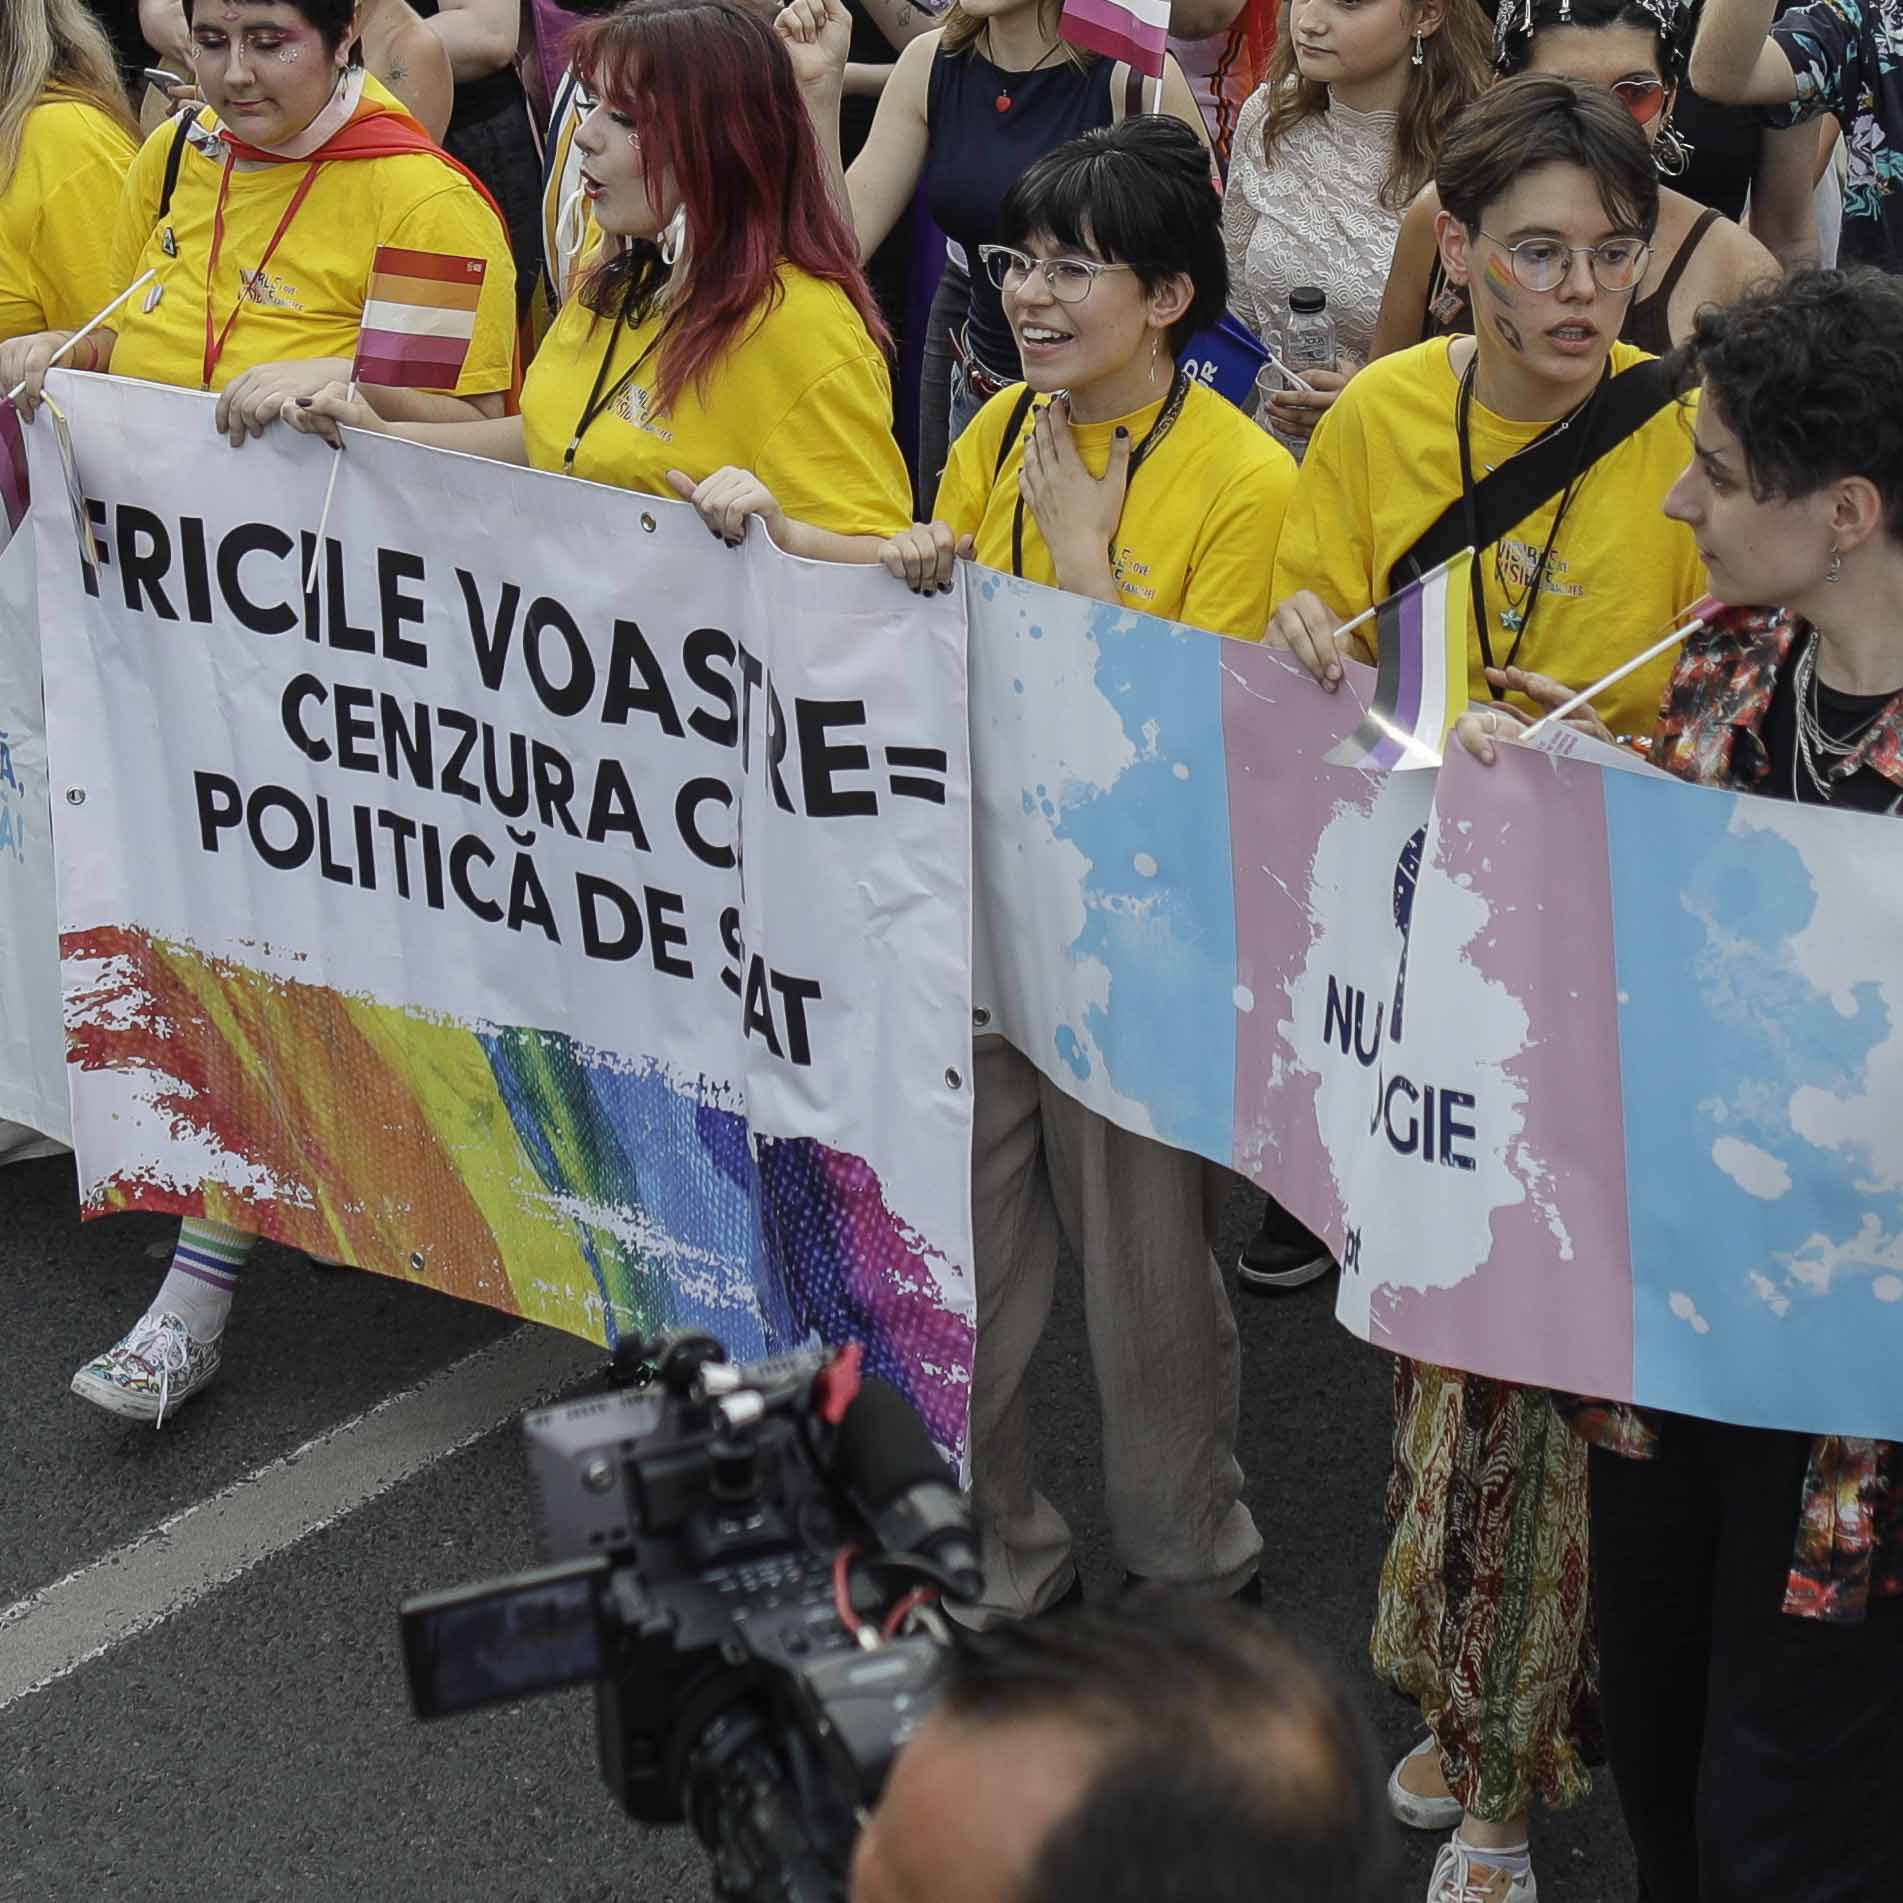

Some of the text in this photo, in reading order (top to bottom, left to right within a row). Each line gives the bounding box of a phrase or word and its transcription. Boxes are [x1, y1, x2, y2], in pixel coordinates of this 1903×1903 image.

[82, 498, 429, 669] FRICILE
[281, 671, 651, 853] CENZURA
[194, 769, 563, 944] POLITICĂ
[576, 872, 694, 980] DE
[1323, 974, 1384, 1067] NU
[1372, 1068, 1477, 1171] GIE
